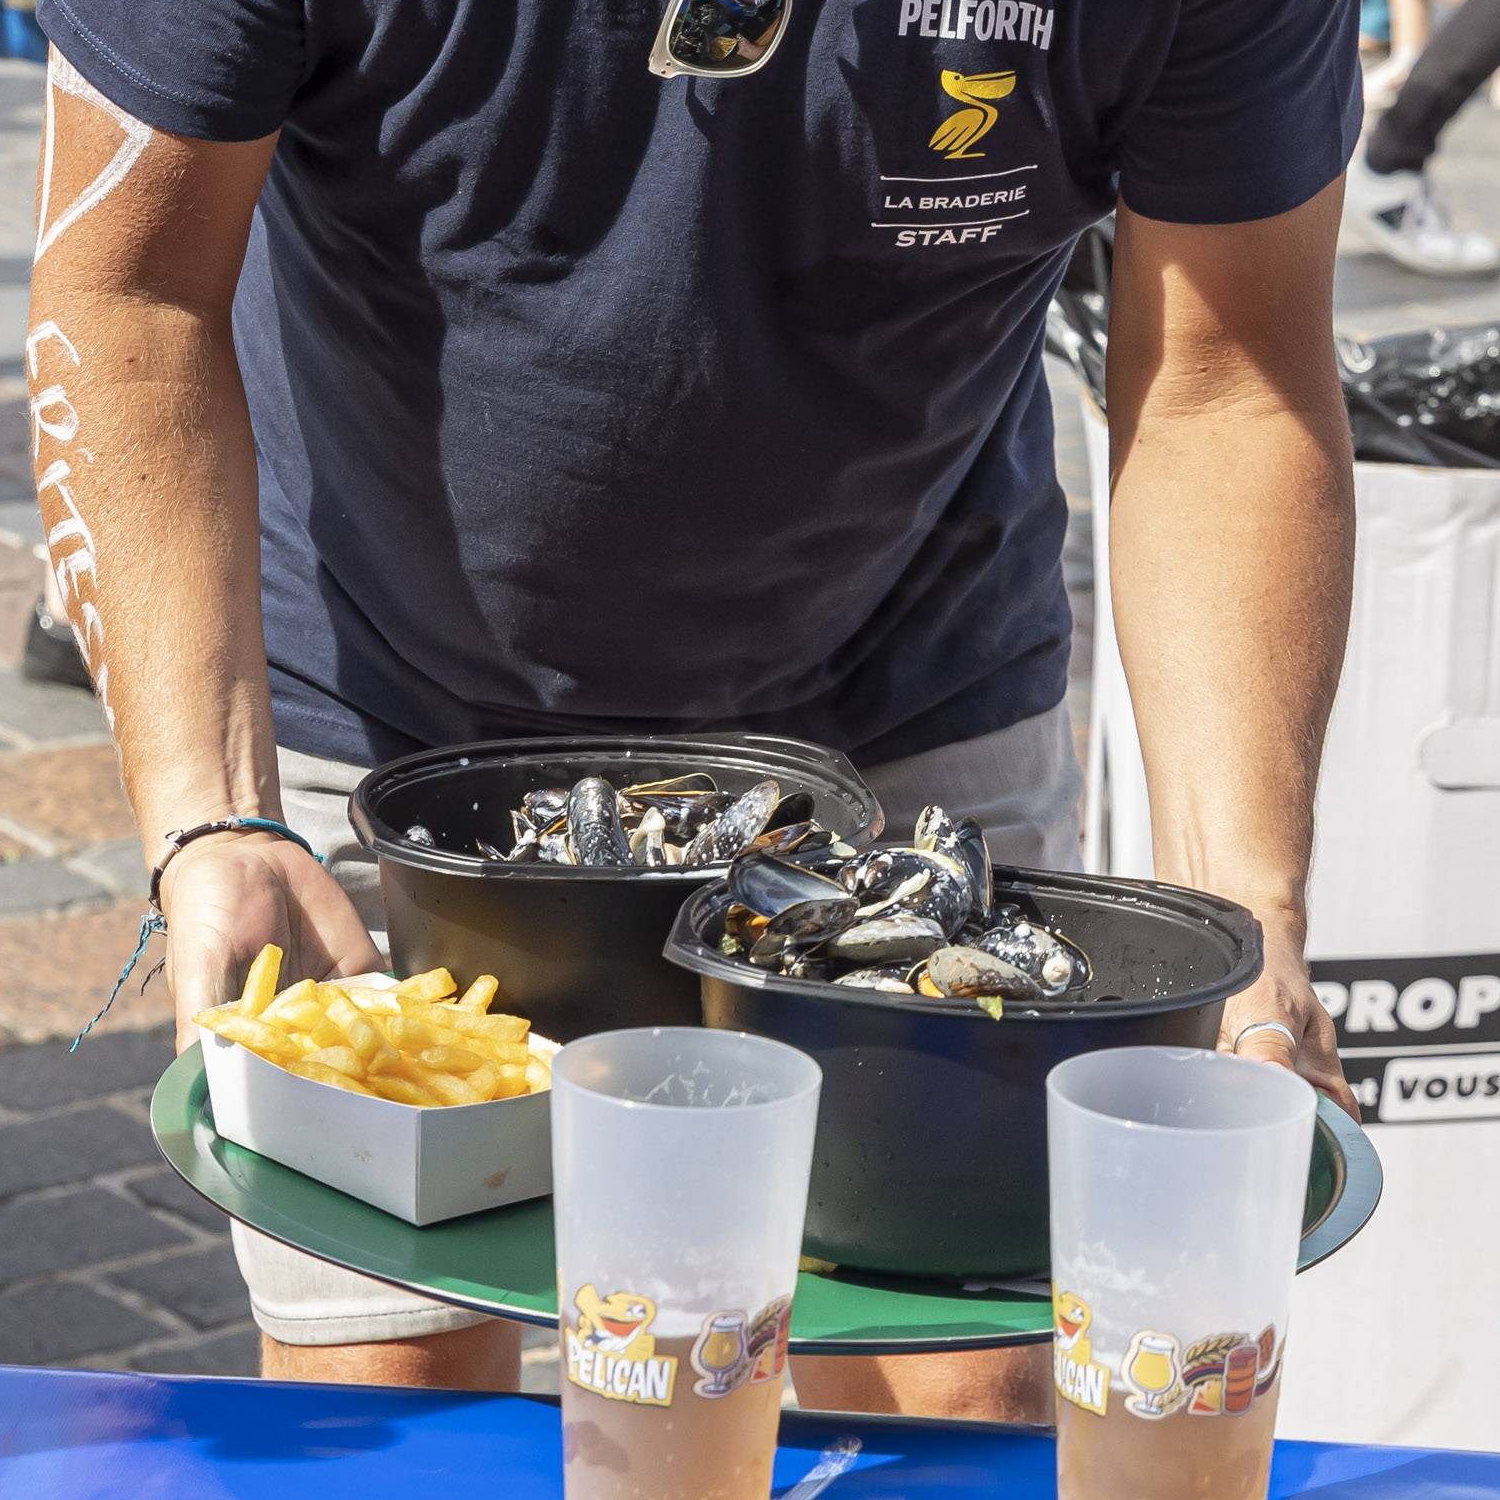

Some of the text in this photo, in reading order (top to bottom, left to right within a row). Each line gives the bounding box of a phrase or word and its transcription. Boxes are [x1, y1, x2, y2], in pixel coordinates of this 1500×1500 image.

[884, 185, 1027, 209] LA BRADERIE
[895, 224, 1002, 247] STAFF
